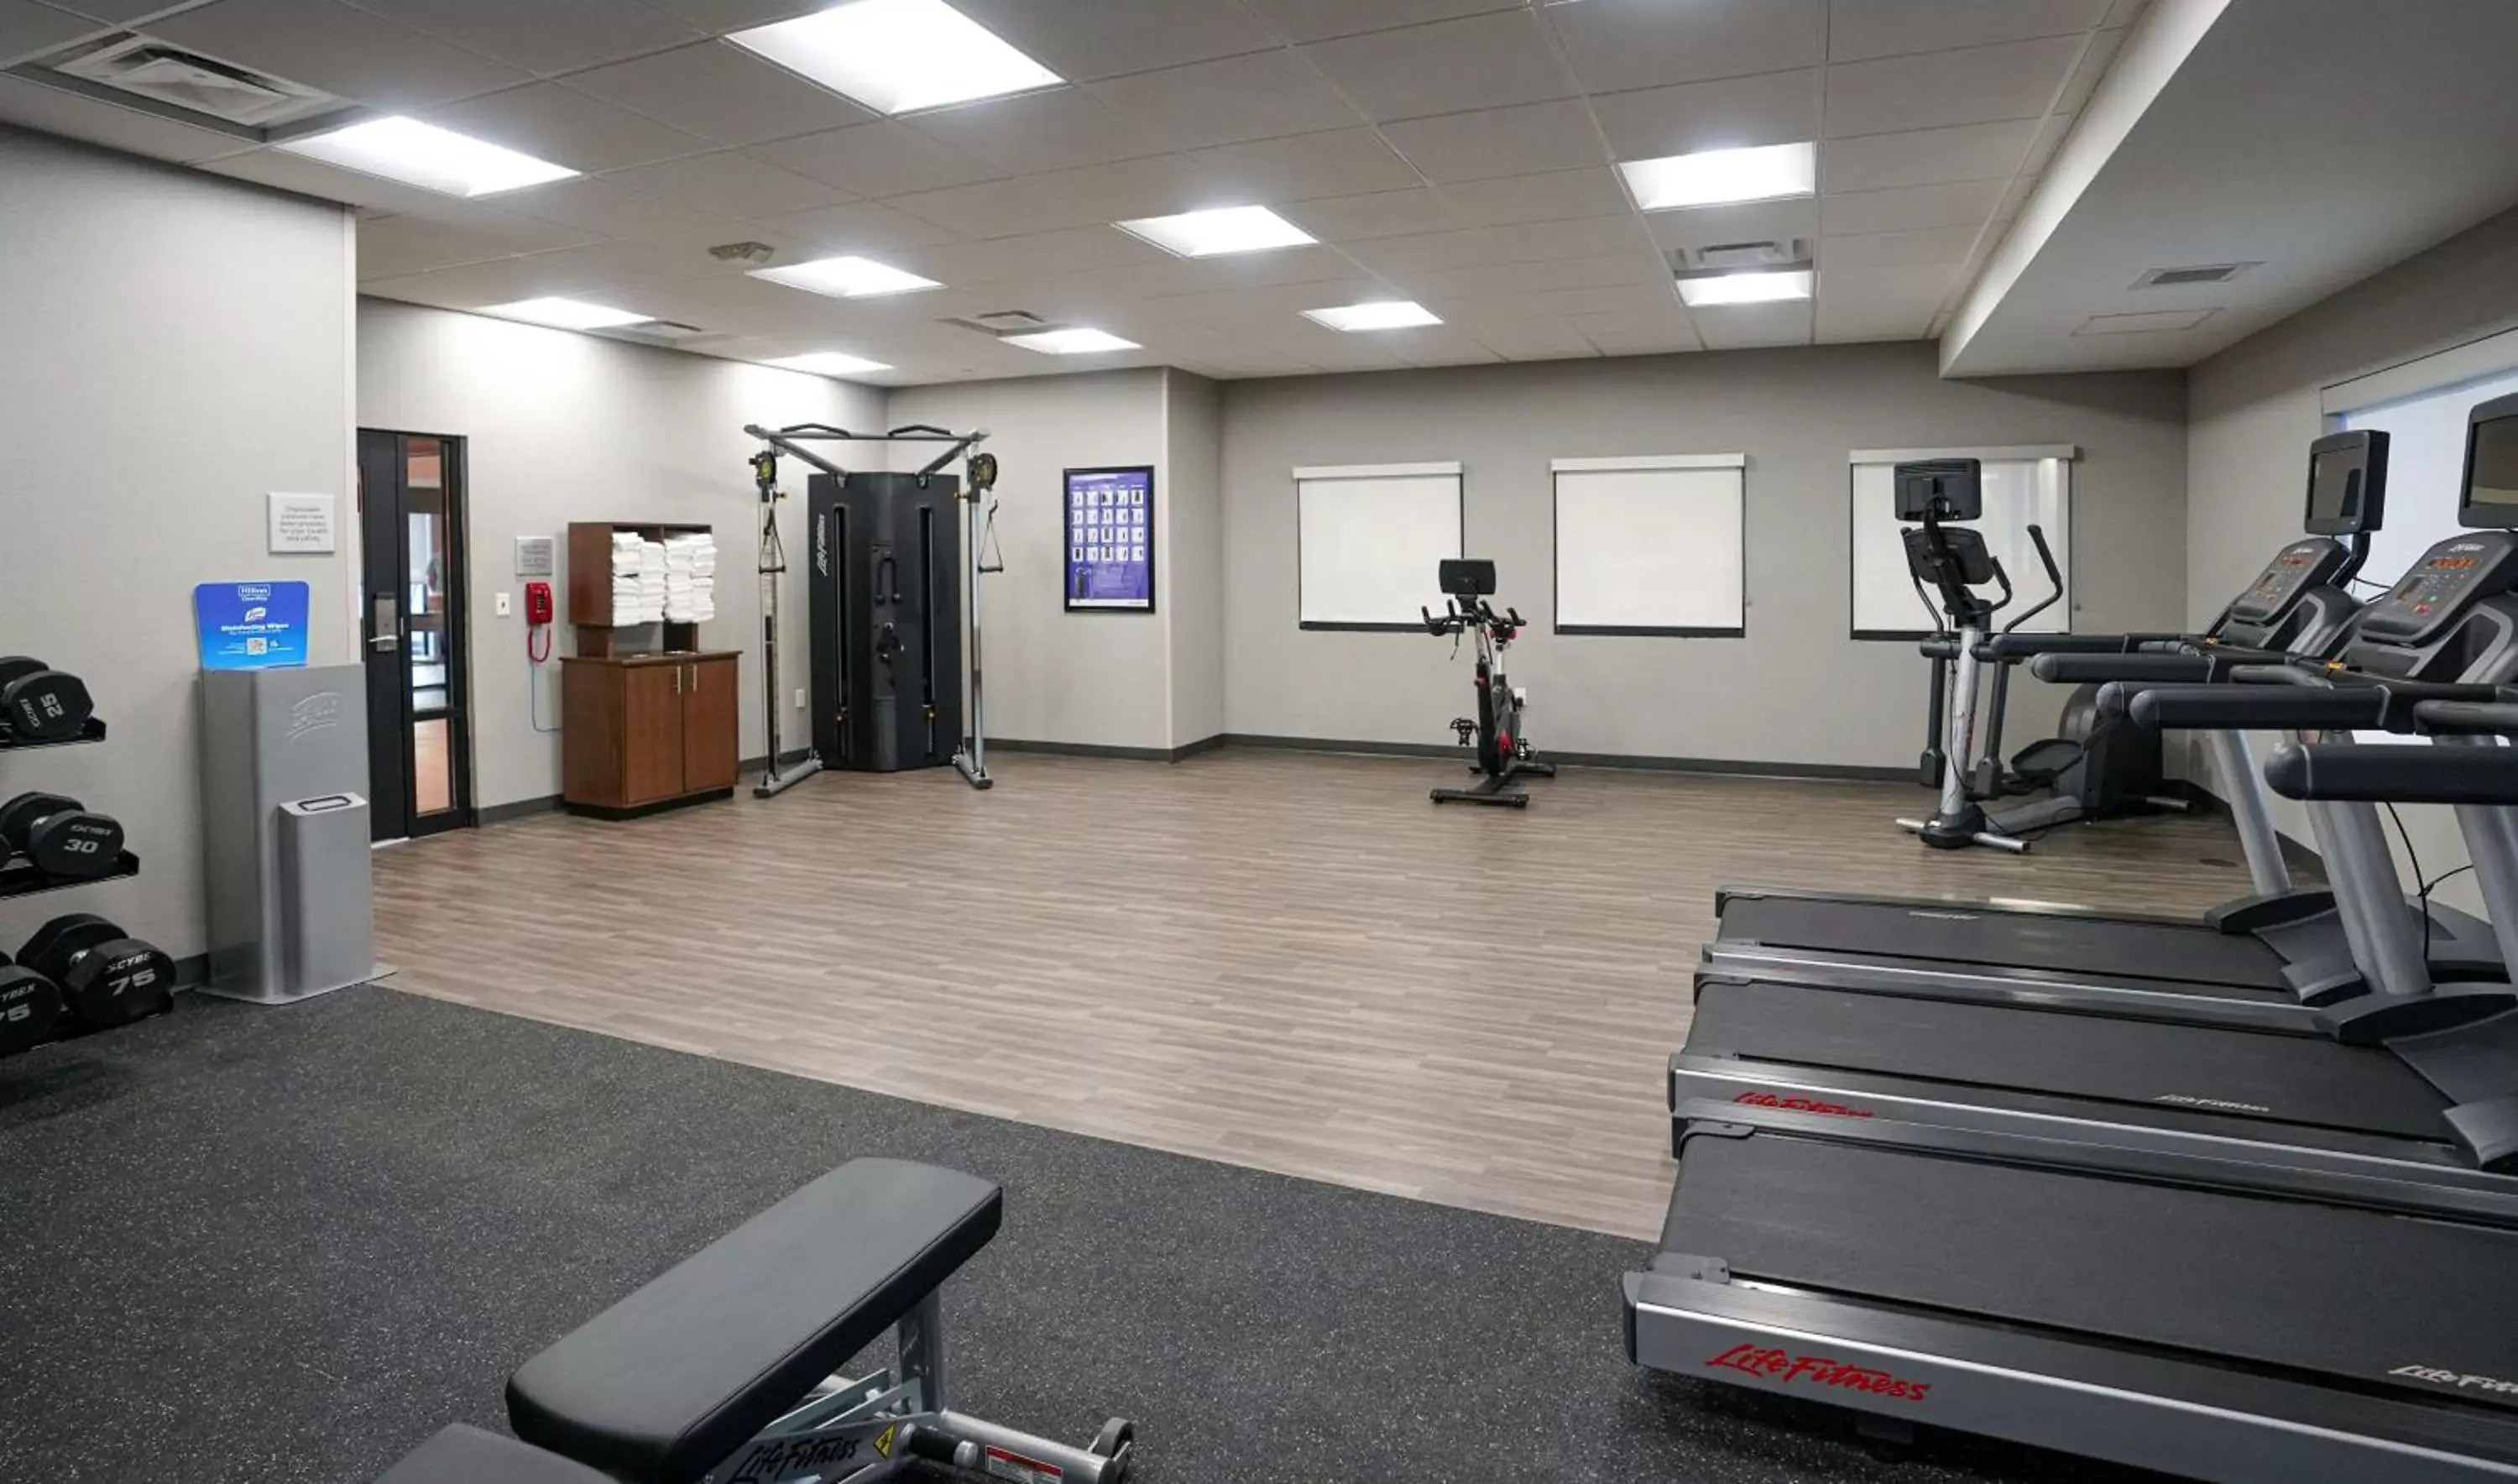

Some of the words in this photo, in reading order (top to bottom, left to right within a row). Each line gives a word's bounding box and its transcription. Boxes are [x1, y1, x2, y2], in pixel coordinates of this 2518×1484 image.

[39, 692, 64, 718] 25
[63, 839, 98, 854] 30
[0, 983, 36, 1002] YBEX
[107, 968, 155, 996] 75
